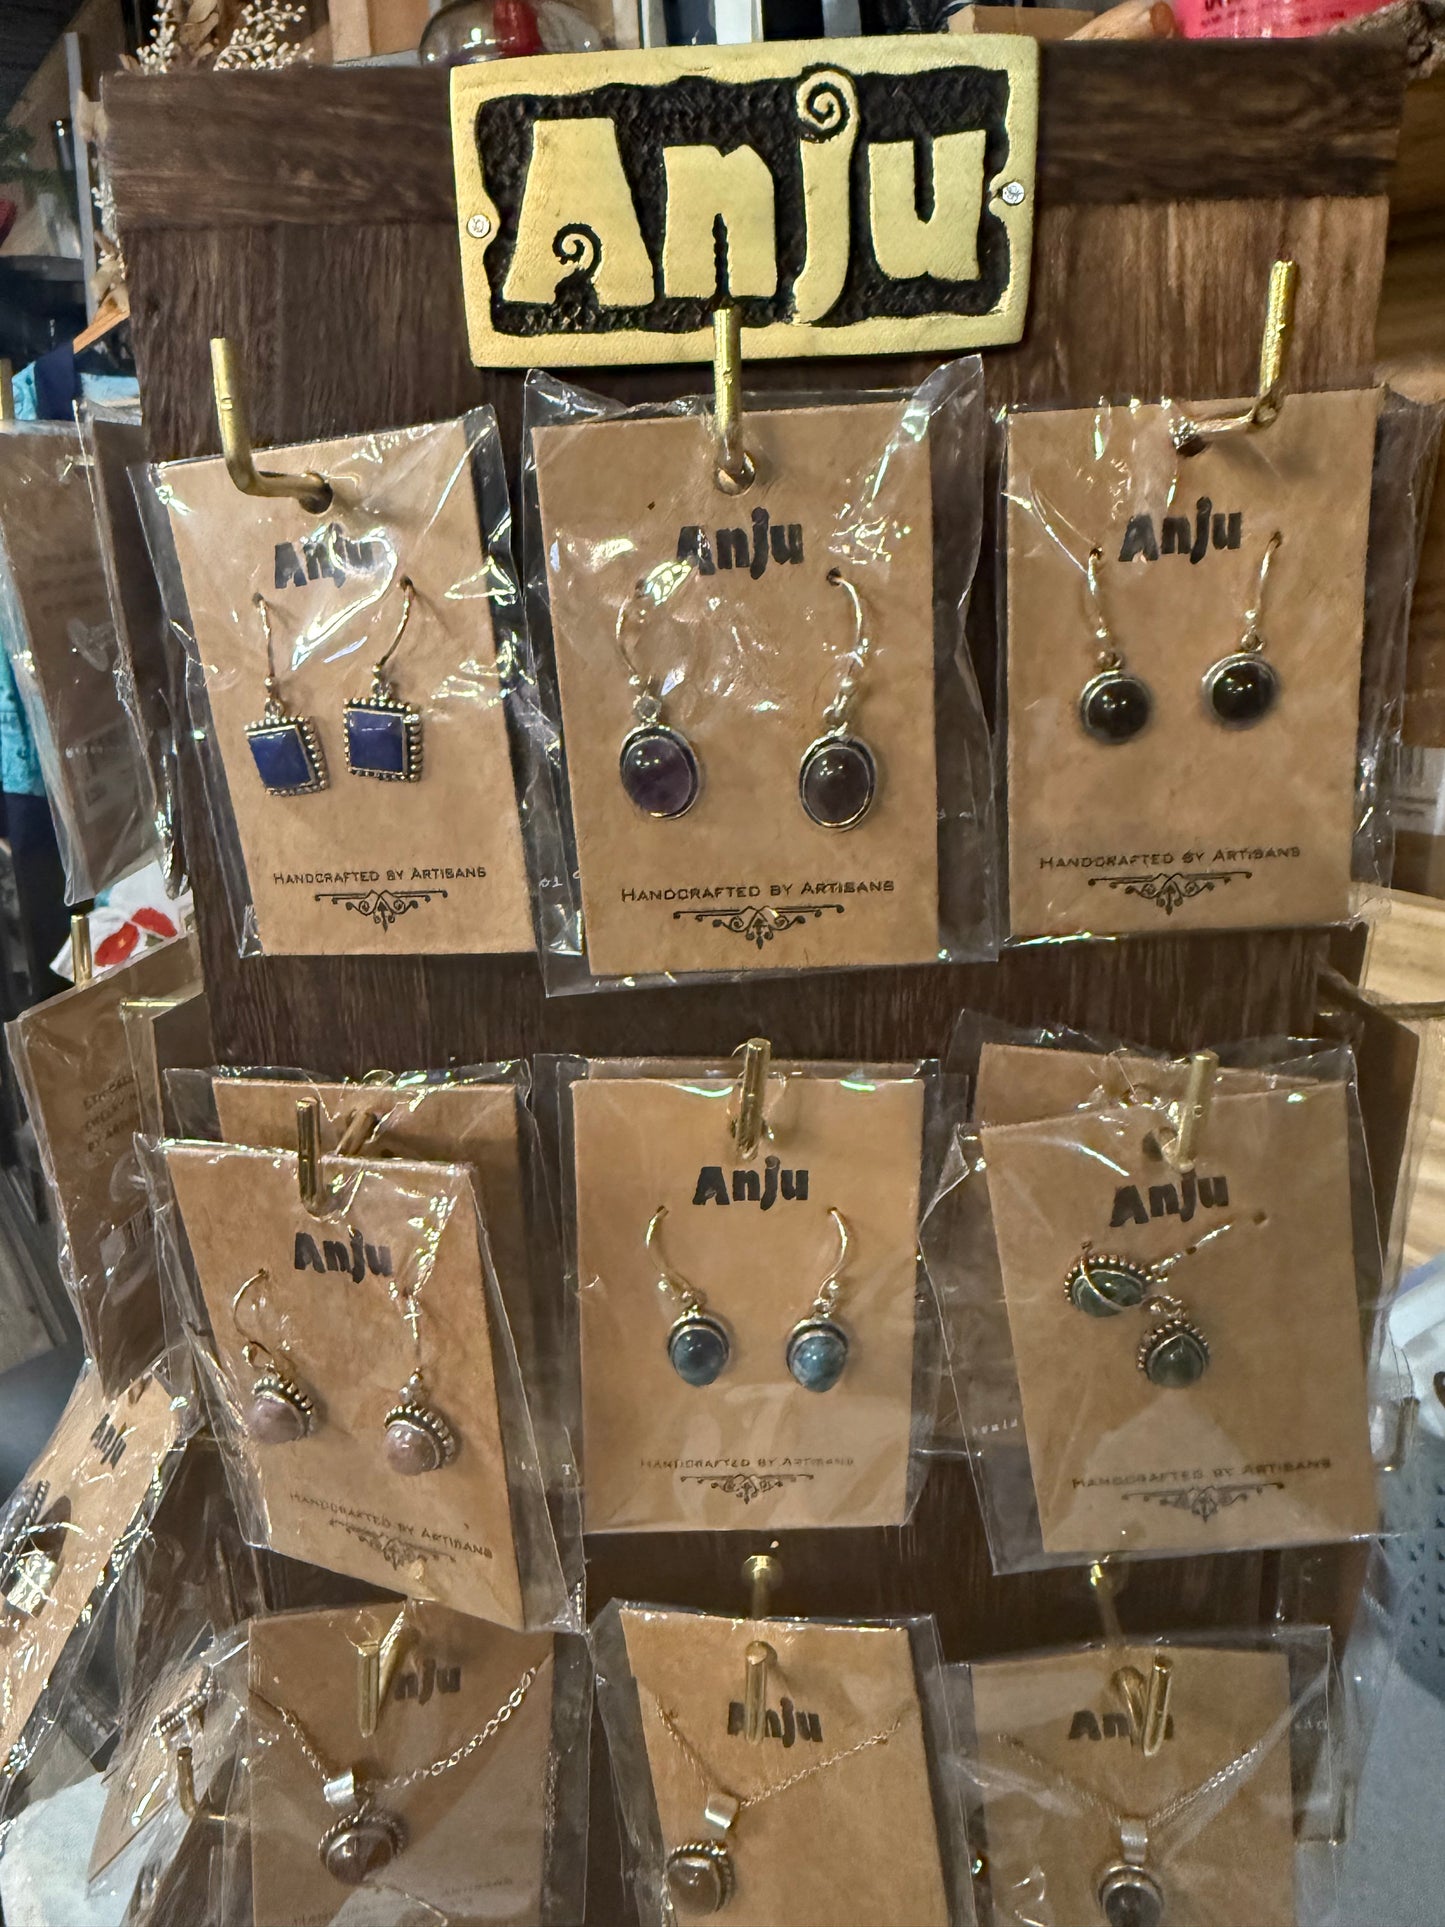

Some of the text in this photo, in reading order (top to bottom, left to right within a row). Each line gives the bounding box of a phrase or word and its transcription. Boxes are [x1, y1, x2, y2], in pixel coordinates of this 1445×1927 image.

[501, 64, 986, 325] Anju
[677, 507, 804, 580] Anju
[1118, 496, 1242, 565] Anju
[692, 1155, 808, 1211] Anju
[1109, 1169, 1229, 1227] Anju
[294, 1229, 393, 1284] Anju
